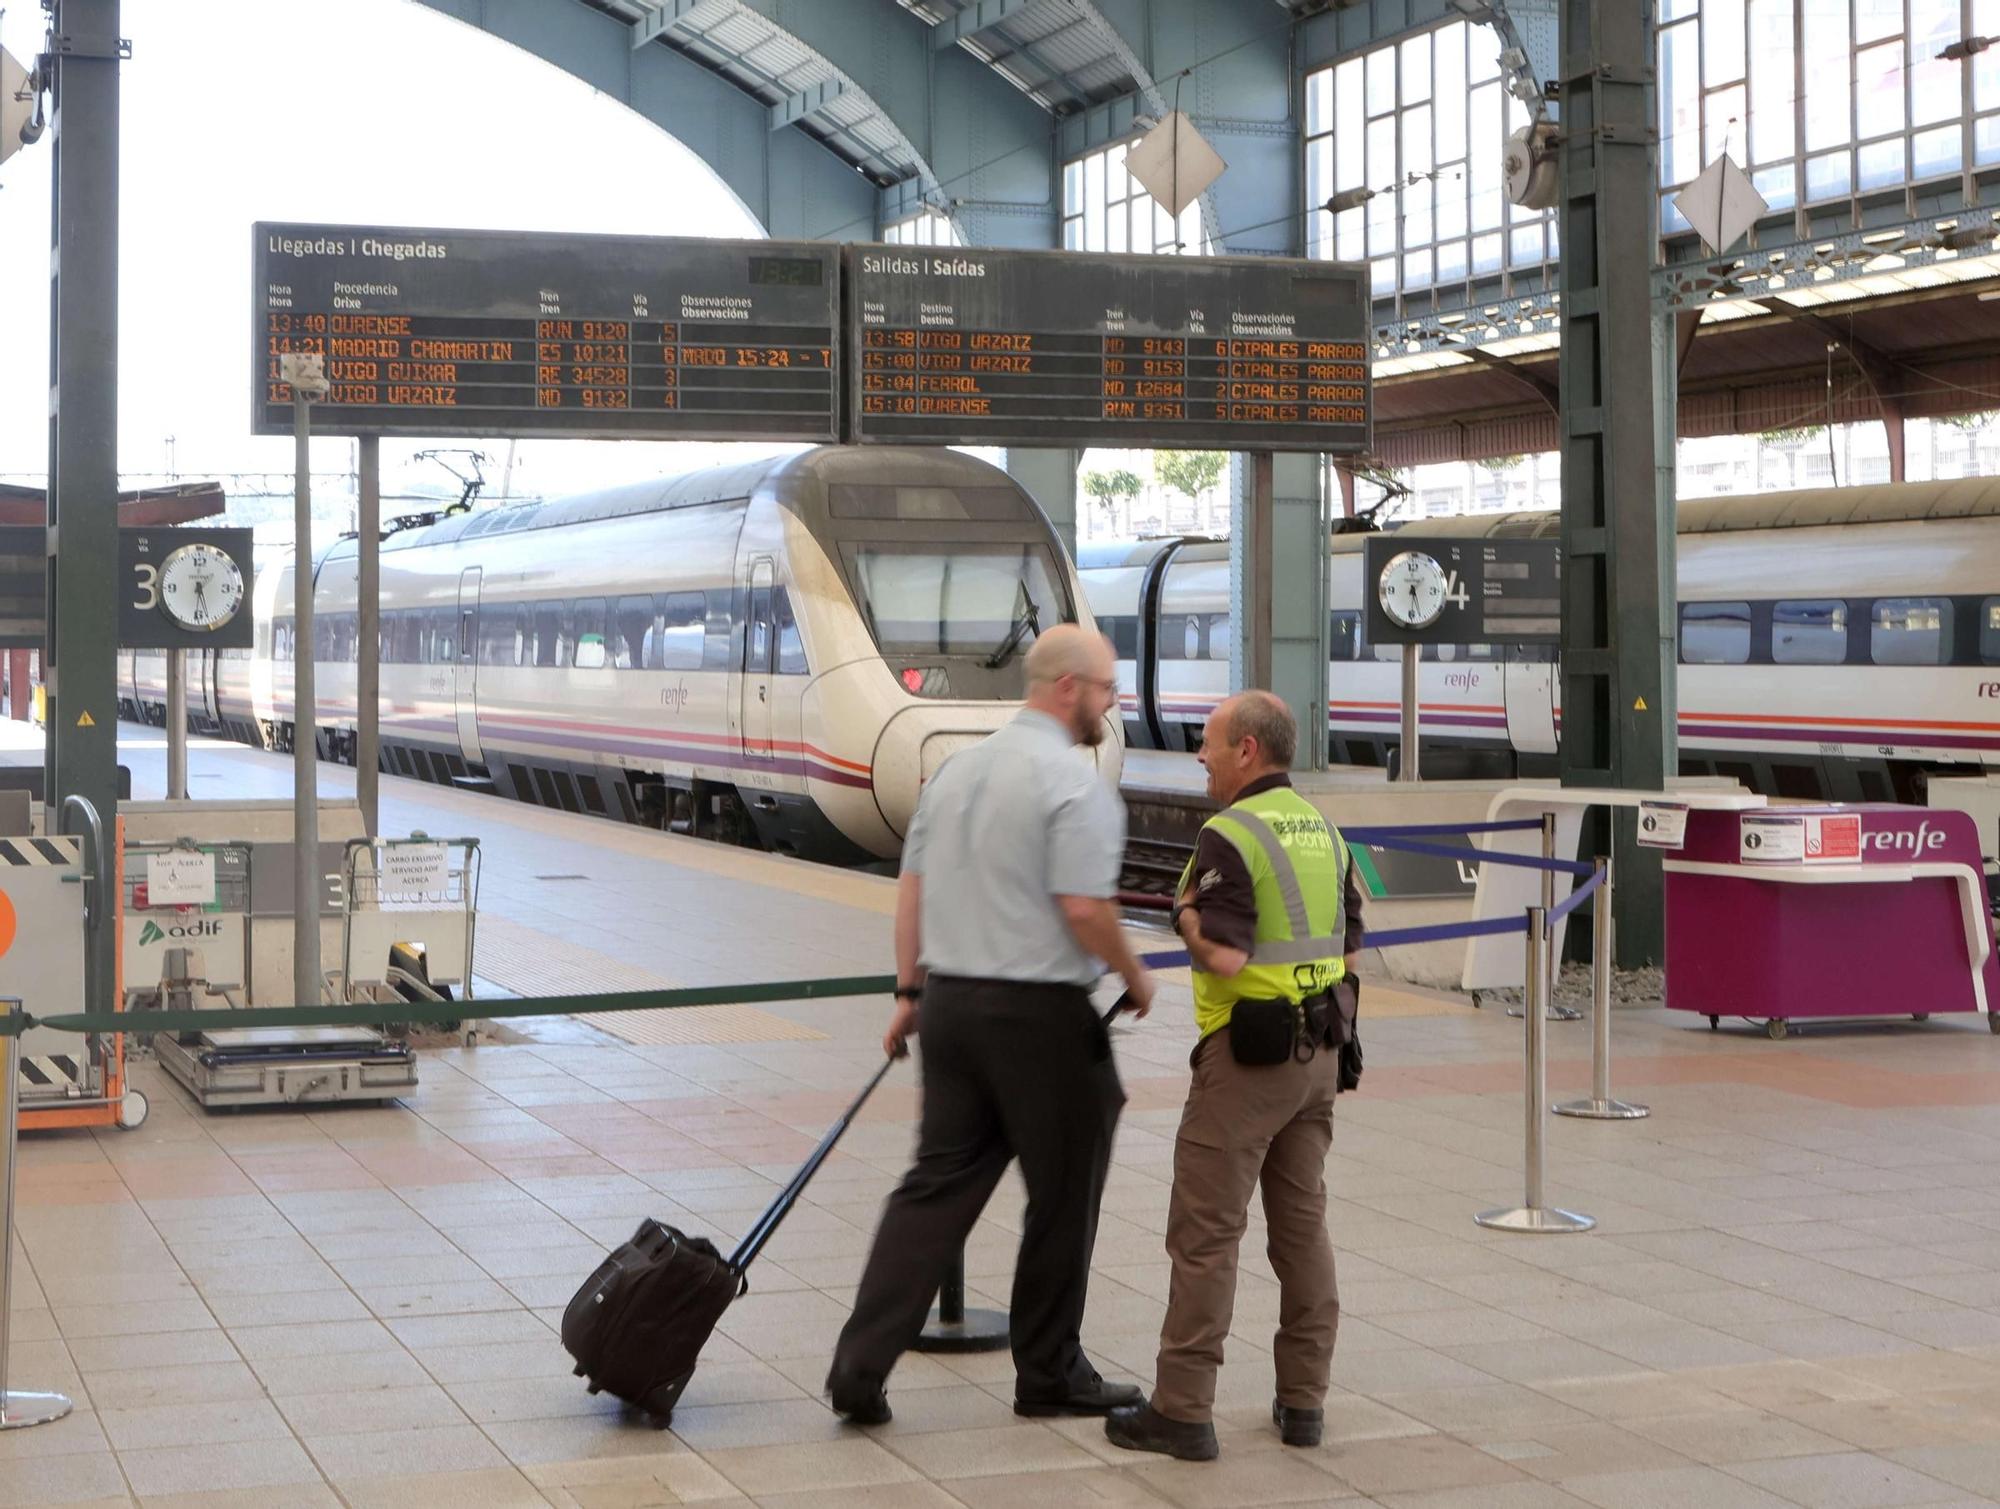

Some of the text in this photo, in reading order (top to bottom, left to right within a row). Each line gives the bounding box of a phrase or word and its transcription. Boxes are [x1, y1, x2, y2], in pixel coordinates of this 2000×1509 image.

[269, 236, 446, 261] Llegadas Chegadas
[863, 256, 986, 276] Salidas Saídas
[269, 284, 292, 295] Hora
[334, 281, 398, 297] Procedencia
[539, 290, 559, 302] Tren
[680, 294, 752, 309] Observaciones
[269, 297, 292, 308] Hora
[333, 296, 361, 310] Orixe
[539, 303, 560, 315] Tren
[681, 307, 749, 320] Observacións
[864, 301, 885, 312] Hora
[920, 302, 953, 314] Destino
[1106, 309, 1124, 319] Tren
[1232, 311, 1296, 325] Observaciones
[864, 313, 885, 324] Hora
[920, 315, 954, 326] Destino
[1106, 321, 1125, 332] Tren
[1232, 323, 1293, 336] Observacións
[269, 314, 326, 333] 13:40
[331, 315, 412, 336] OURENSE
[582, 322, 627, 340] 9120
[663, 323, 676, 341] 5
[269, 336, 325, 356] 14:21
[331, 337, 400, 359] MADRID
[411, 341, 512, 362] CHAMARTIN
[538, 343, 561, 362] ES
[573, 344, 627, 364] 10121
[664, 346, 676, 364] 6
[736, 349, 790, 368] 15:24
[864, 330, 1365, 361] 13:58 VIGO URZAIZ MD 9143 6 CIPALES PARADA
[331, 361, 676, 386] VIGO GUIXAR RE 34528 3
[864, 352, 916, 370] 15:00
[920, 354, 961, 371] VIGO
[970, 356, 1032, 374] URZAIZ
[1104, 358, 1125, 376] MD
[1143, 359, 1184, 377] 9153
[1231, 361, 1299, 381] CIPALES
[1307, 363, 1365, 382] PARADA
[331, 384, 378, 404] VIGO
[388, 385, 457, 406] URZAIZ
[538, 388, 561, 407] MD
[582, 389, 627, 408] 9132
[664, 390, 675, 408] 4
[864, 374, 1365, 403] 15:04 FERROL MD 12684 2 CIPALES PARADA
[864, 396, 915, 413] 15:10
[920, 397, 991, 416] OURENSE
[1143, 402, 1184, 420] 9351
[1216, 403, 1227, 420] 5
[1231, 405, 1299, 423] CIPALES
[1307, 406, 1365, 424] PARADA
[133, 563, 158, 610] 3
[168, 583, 230, 594] 9 3
[1429, 587, 1437, 596] 3
[1446, 569, 1471, 611] 4
[1444, 667, 1480, 694] renfe
[660, 676, 689, 714] renfe
[1861, 819, 1947, 859] renfe
[168, 919, 224, 938] adif
